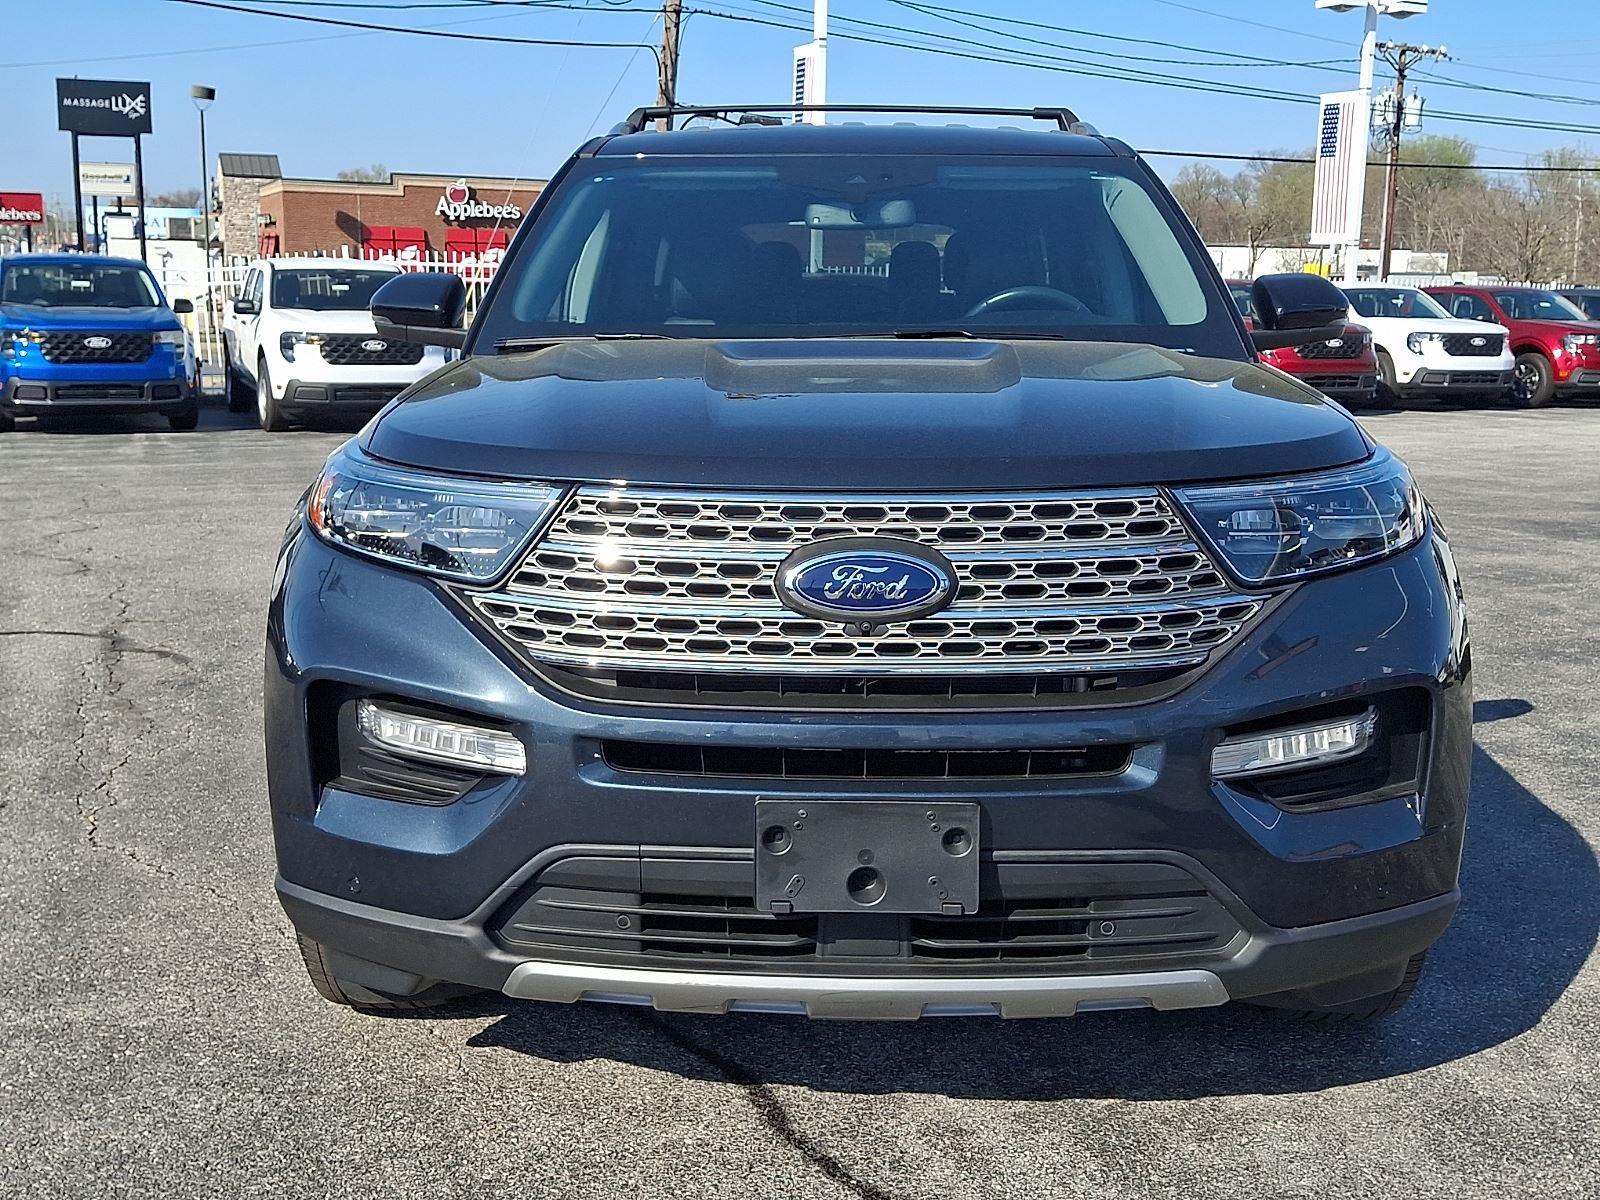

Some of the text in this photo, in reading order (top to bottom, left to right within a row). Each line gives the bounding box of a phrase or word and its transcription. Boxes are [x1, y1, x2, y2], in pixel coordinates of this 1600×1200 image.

[63, 97, 110, 109] MASSAGE
[0, 206, 41, 220] lebee's
[435, 195, 521, 221] Applebee's
[823, 564, 910, 600] Ford
